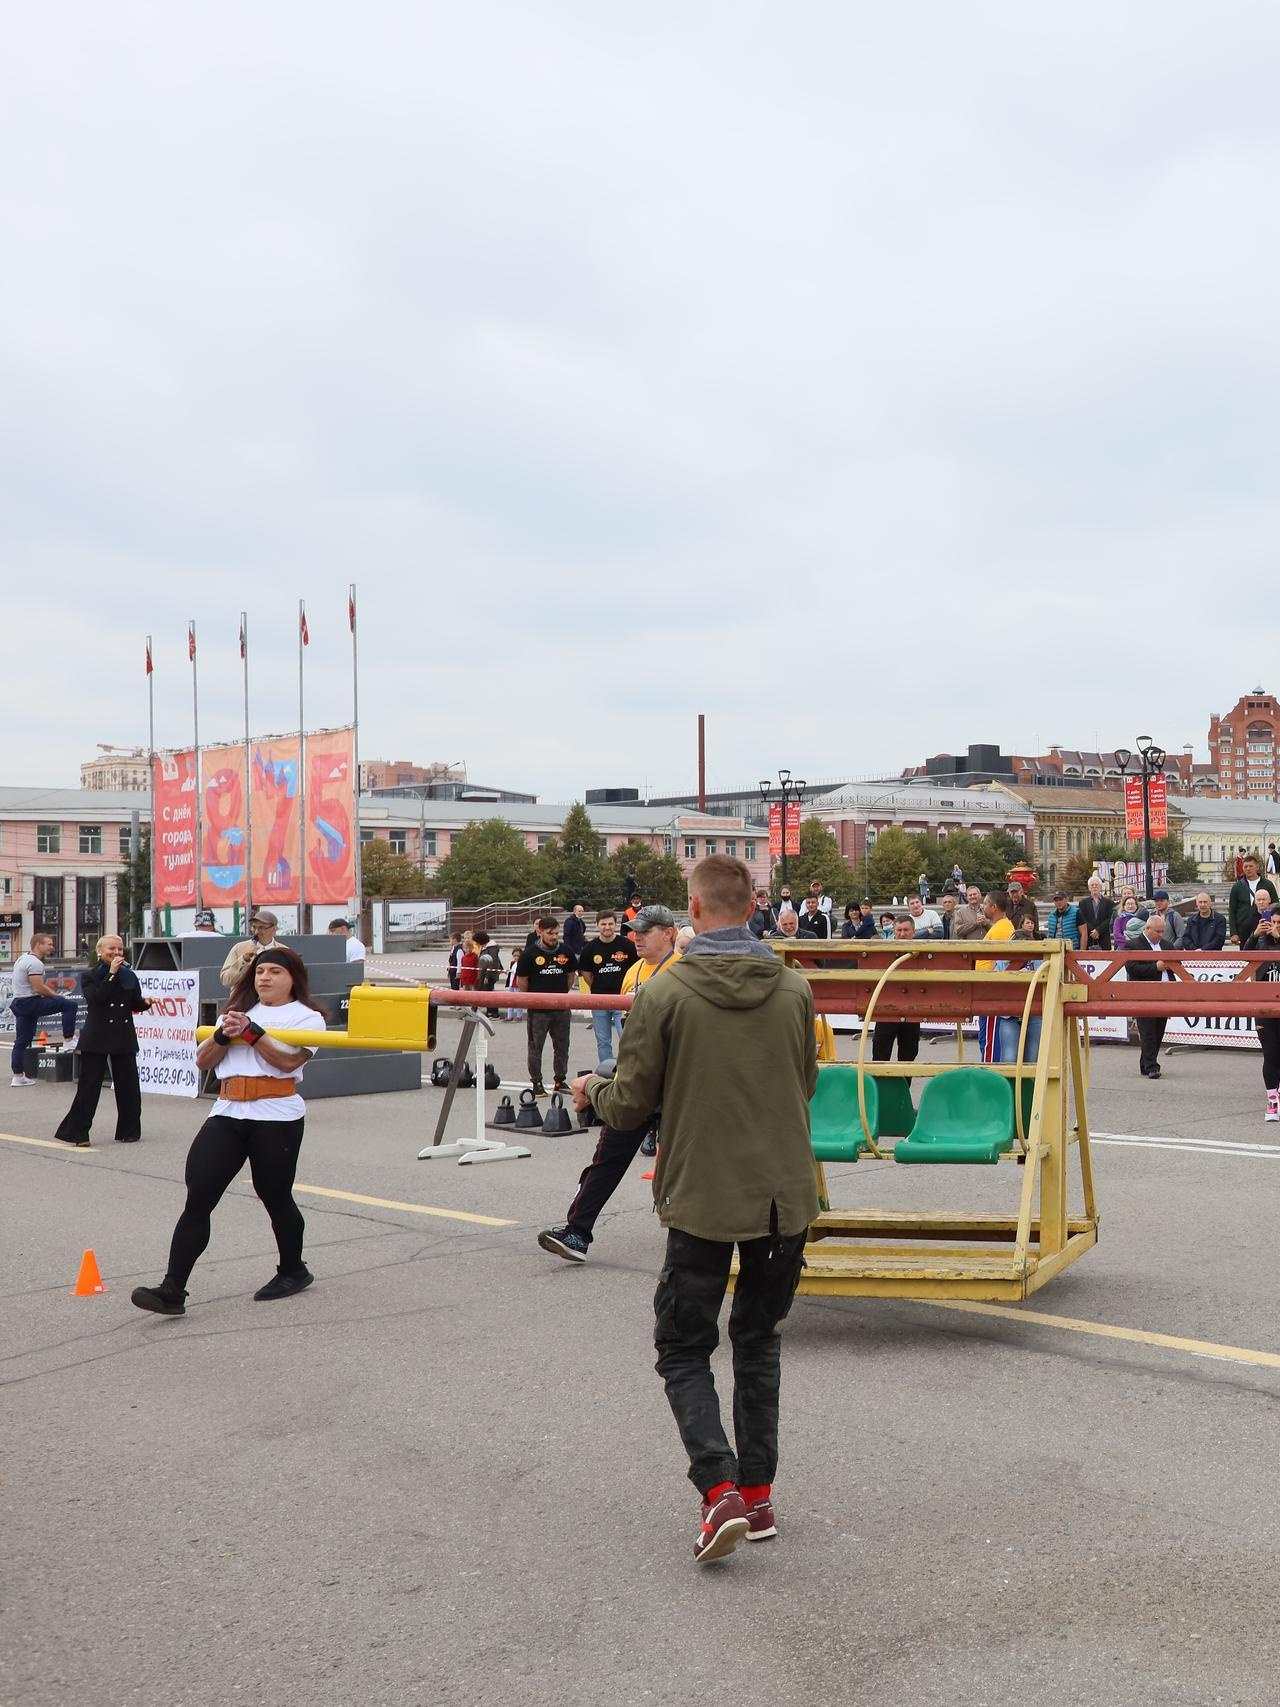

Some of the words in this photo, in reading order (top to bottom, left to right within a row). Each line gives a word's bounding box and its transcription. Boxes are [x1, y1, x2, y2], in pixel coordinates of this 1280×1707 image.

[162, 806, 170, 821] С
[162, 850, 194, 871] туляки!
[138, 978, 195, 992] НЕС-ЦЕНТР
[132, 997, 193, 1017] ЛЮТ»
